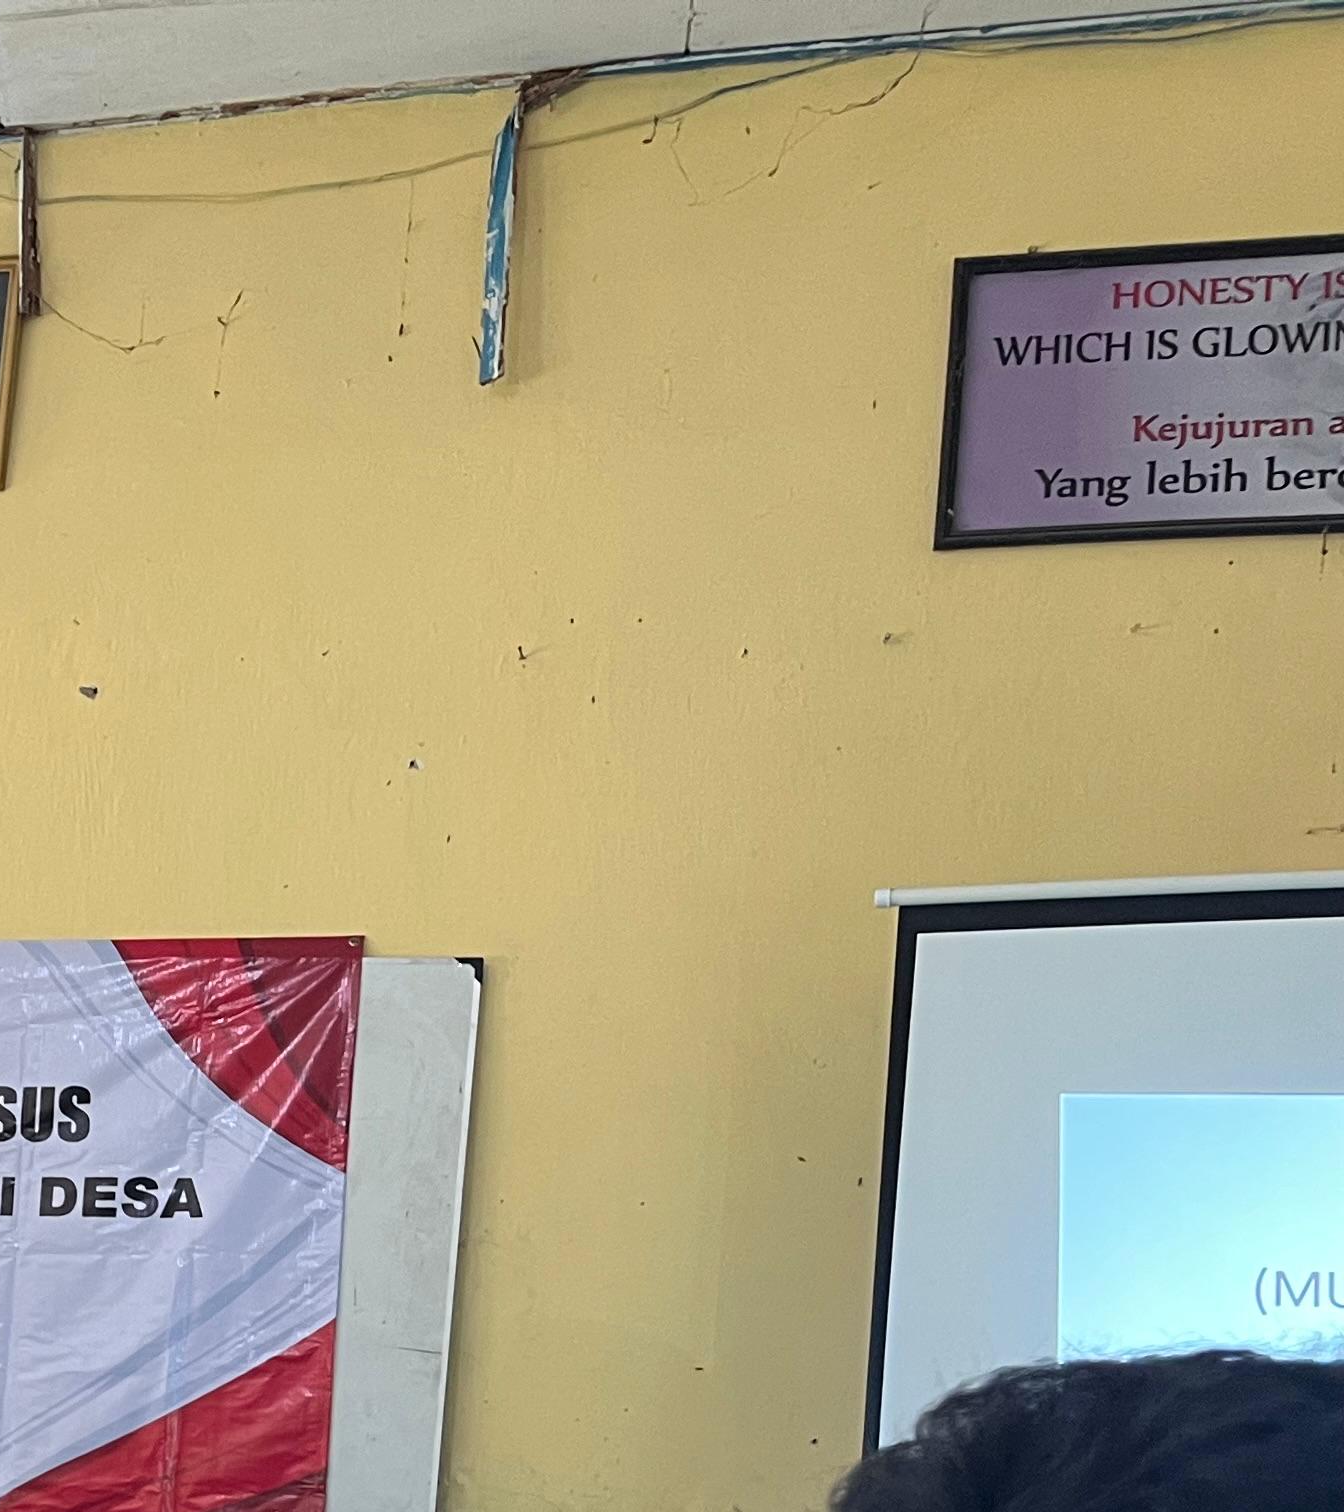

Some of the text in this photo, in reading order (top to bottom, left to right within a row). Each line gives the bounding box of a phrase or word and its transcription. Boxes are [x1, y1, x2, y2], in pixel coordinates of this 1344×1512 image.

[1112, 271, 1310, 310] HONESTY
[994, 330, 1132, 366] WHICH
[1146, 328, 1179, 361] IS
[1132, 412, 1314, 450] Kejujuran
[1034, 468, 1131, 507] Yang
[1146, 457, 1248, 496] lebih
[39, 1176, 203, 1219] DESA
